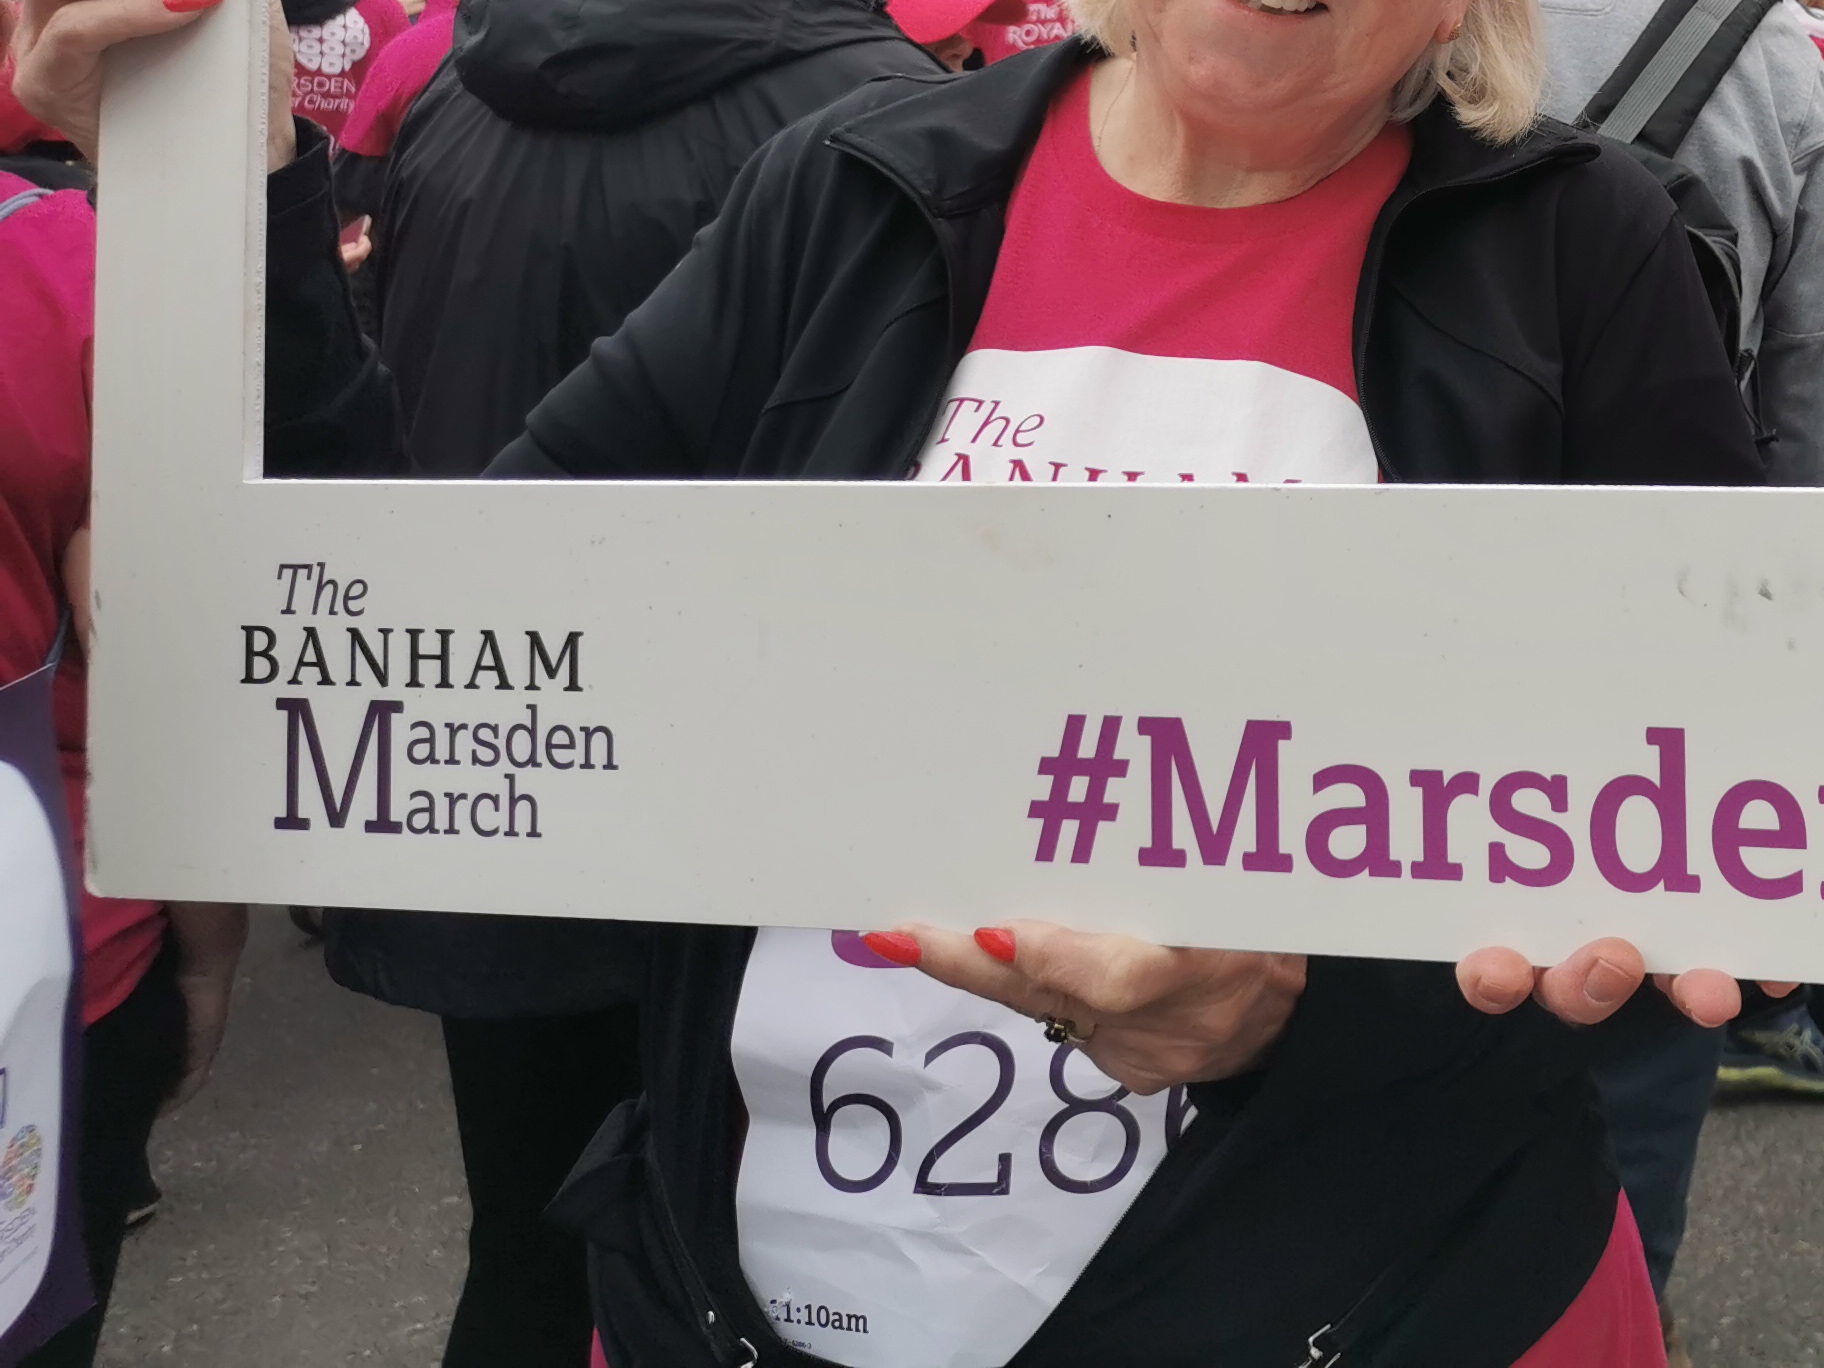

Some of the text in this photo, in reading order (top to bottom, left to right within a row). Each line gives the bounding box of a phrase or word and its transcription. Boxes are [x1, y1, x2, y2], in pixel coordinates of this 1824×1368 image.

[936, 397, 1046, 448] The
[277, 562, 369, 617] The
[241, 625, 584, 692] BANHAM
